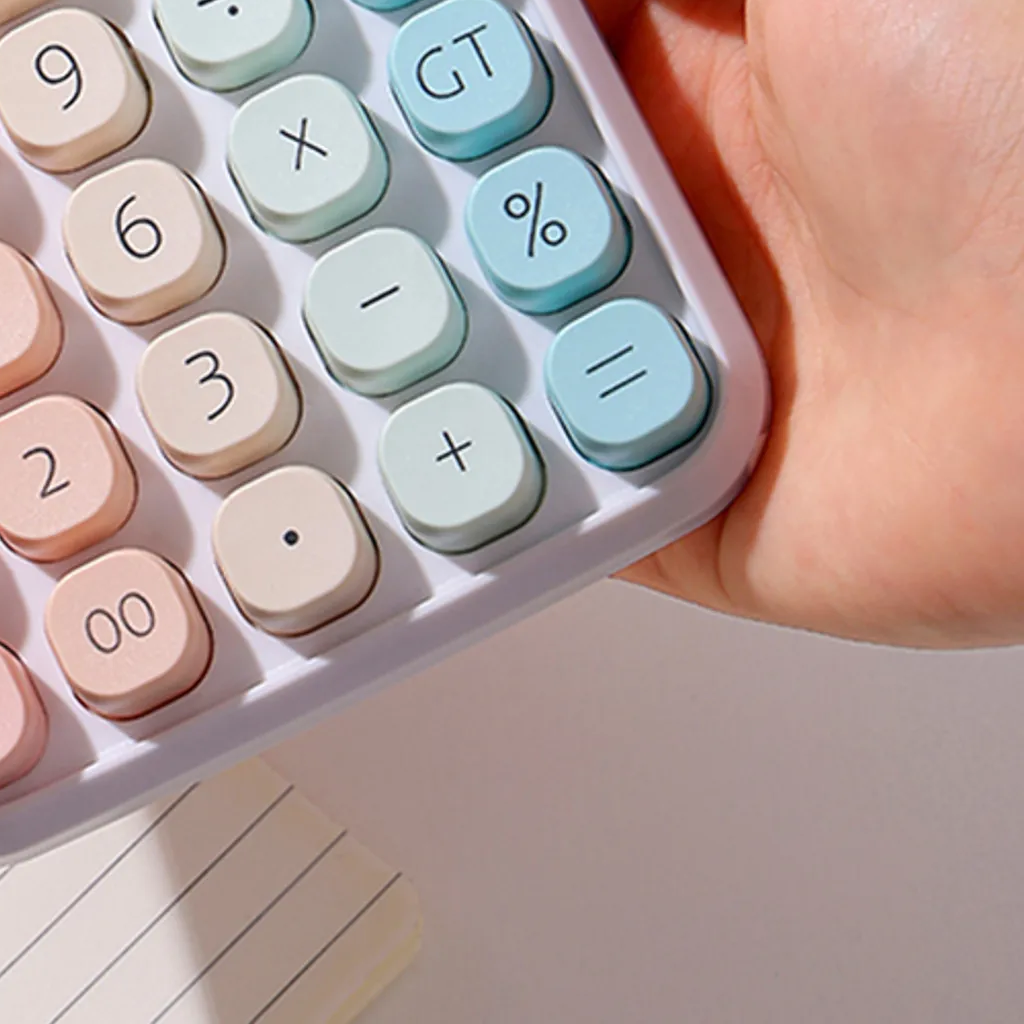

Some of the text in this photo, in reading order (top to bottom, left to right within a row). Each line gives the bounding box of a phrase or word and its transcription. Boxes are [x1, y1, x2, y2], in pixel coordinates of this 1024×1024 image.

[34, 44, 82, 111] 9
[416, 24, 494, 100] GT
[114, 195, 163, 260] 6
[184, 349, 236, 421] 3
[21, 445, 70, 499] 2
[84, 591, 156, 654] 00
